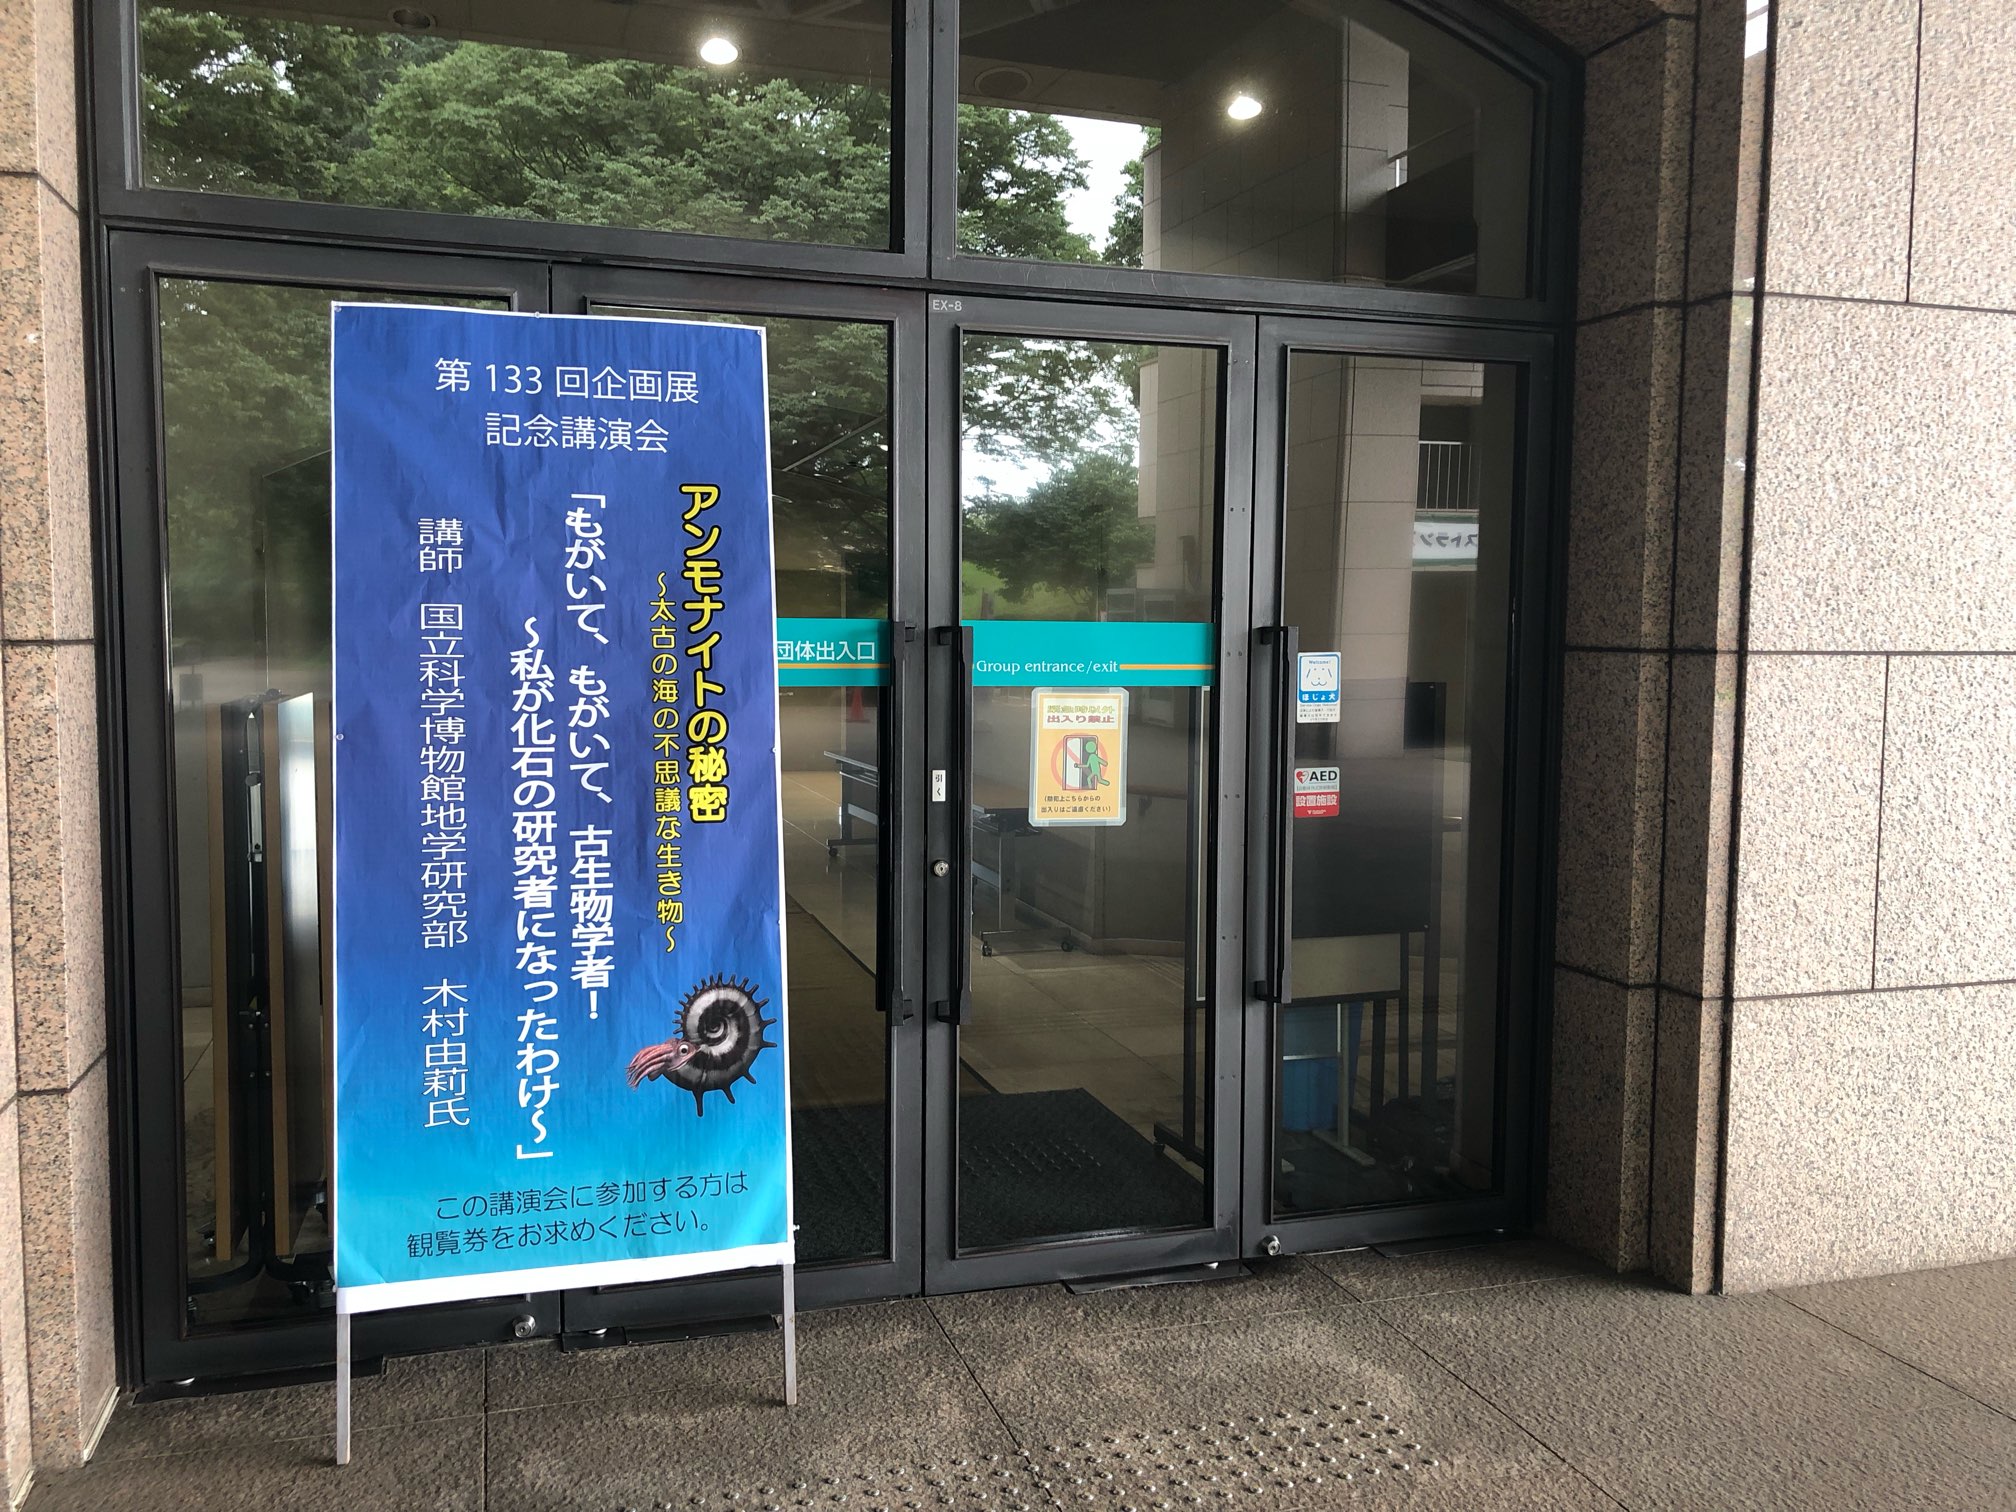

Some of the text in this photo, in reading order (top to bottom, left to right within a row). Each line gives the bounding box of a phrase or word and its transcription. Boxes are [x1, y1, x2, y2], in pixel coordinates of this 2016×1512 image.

[932, 299, 962, 311] EX-8
[434, 357, 699, 404] 第 133 回企画展
[484, 412, 669, 454] 記念講演会
[680, 484, 729, 823] アンモナイトの秘密
[777, 640, 876, 661] 団体出入口
[976, 660, 1119, 675] Group entrance/exit
[1302, 693, 1336, 701] ほじょ犬
[935, 774, 943, 797] 引く
[1309, 770, 1338, 782] AED
[1296, 794, 1338, 807] 設置施設
[417, 517, 471, 1128] 講師 国立科学博物館地学研究部 木村由莉氏
[436, 1170, 749, 1221] この講演会に参加する方は
[407, 1214, 711, 1259] 観覧券をお求めください。
